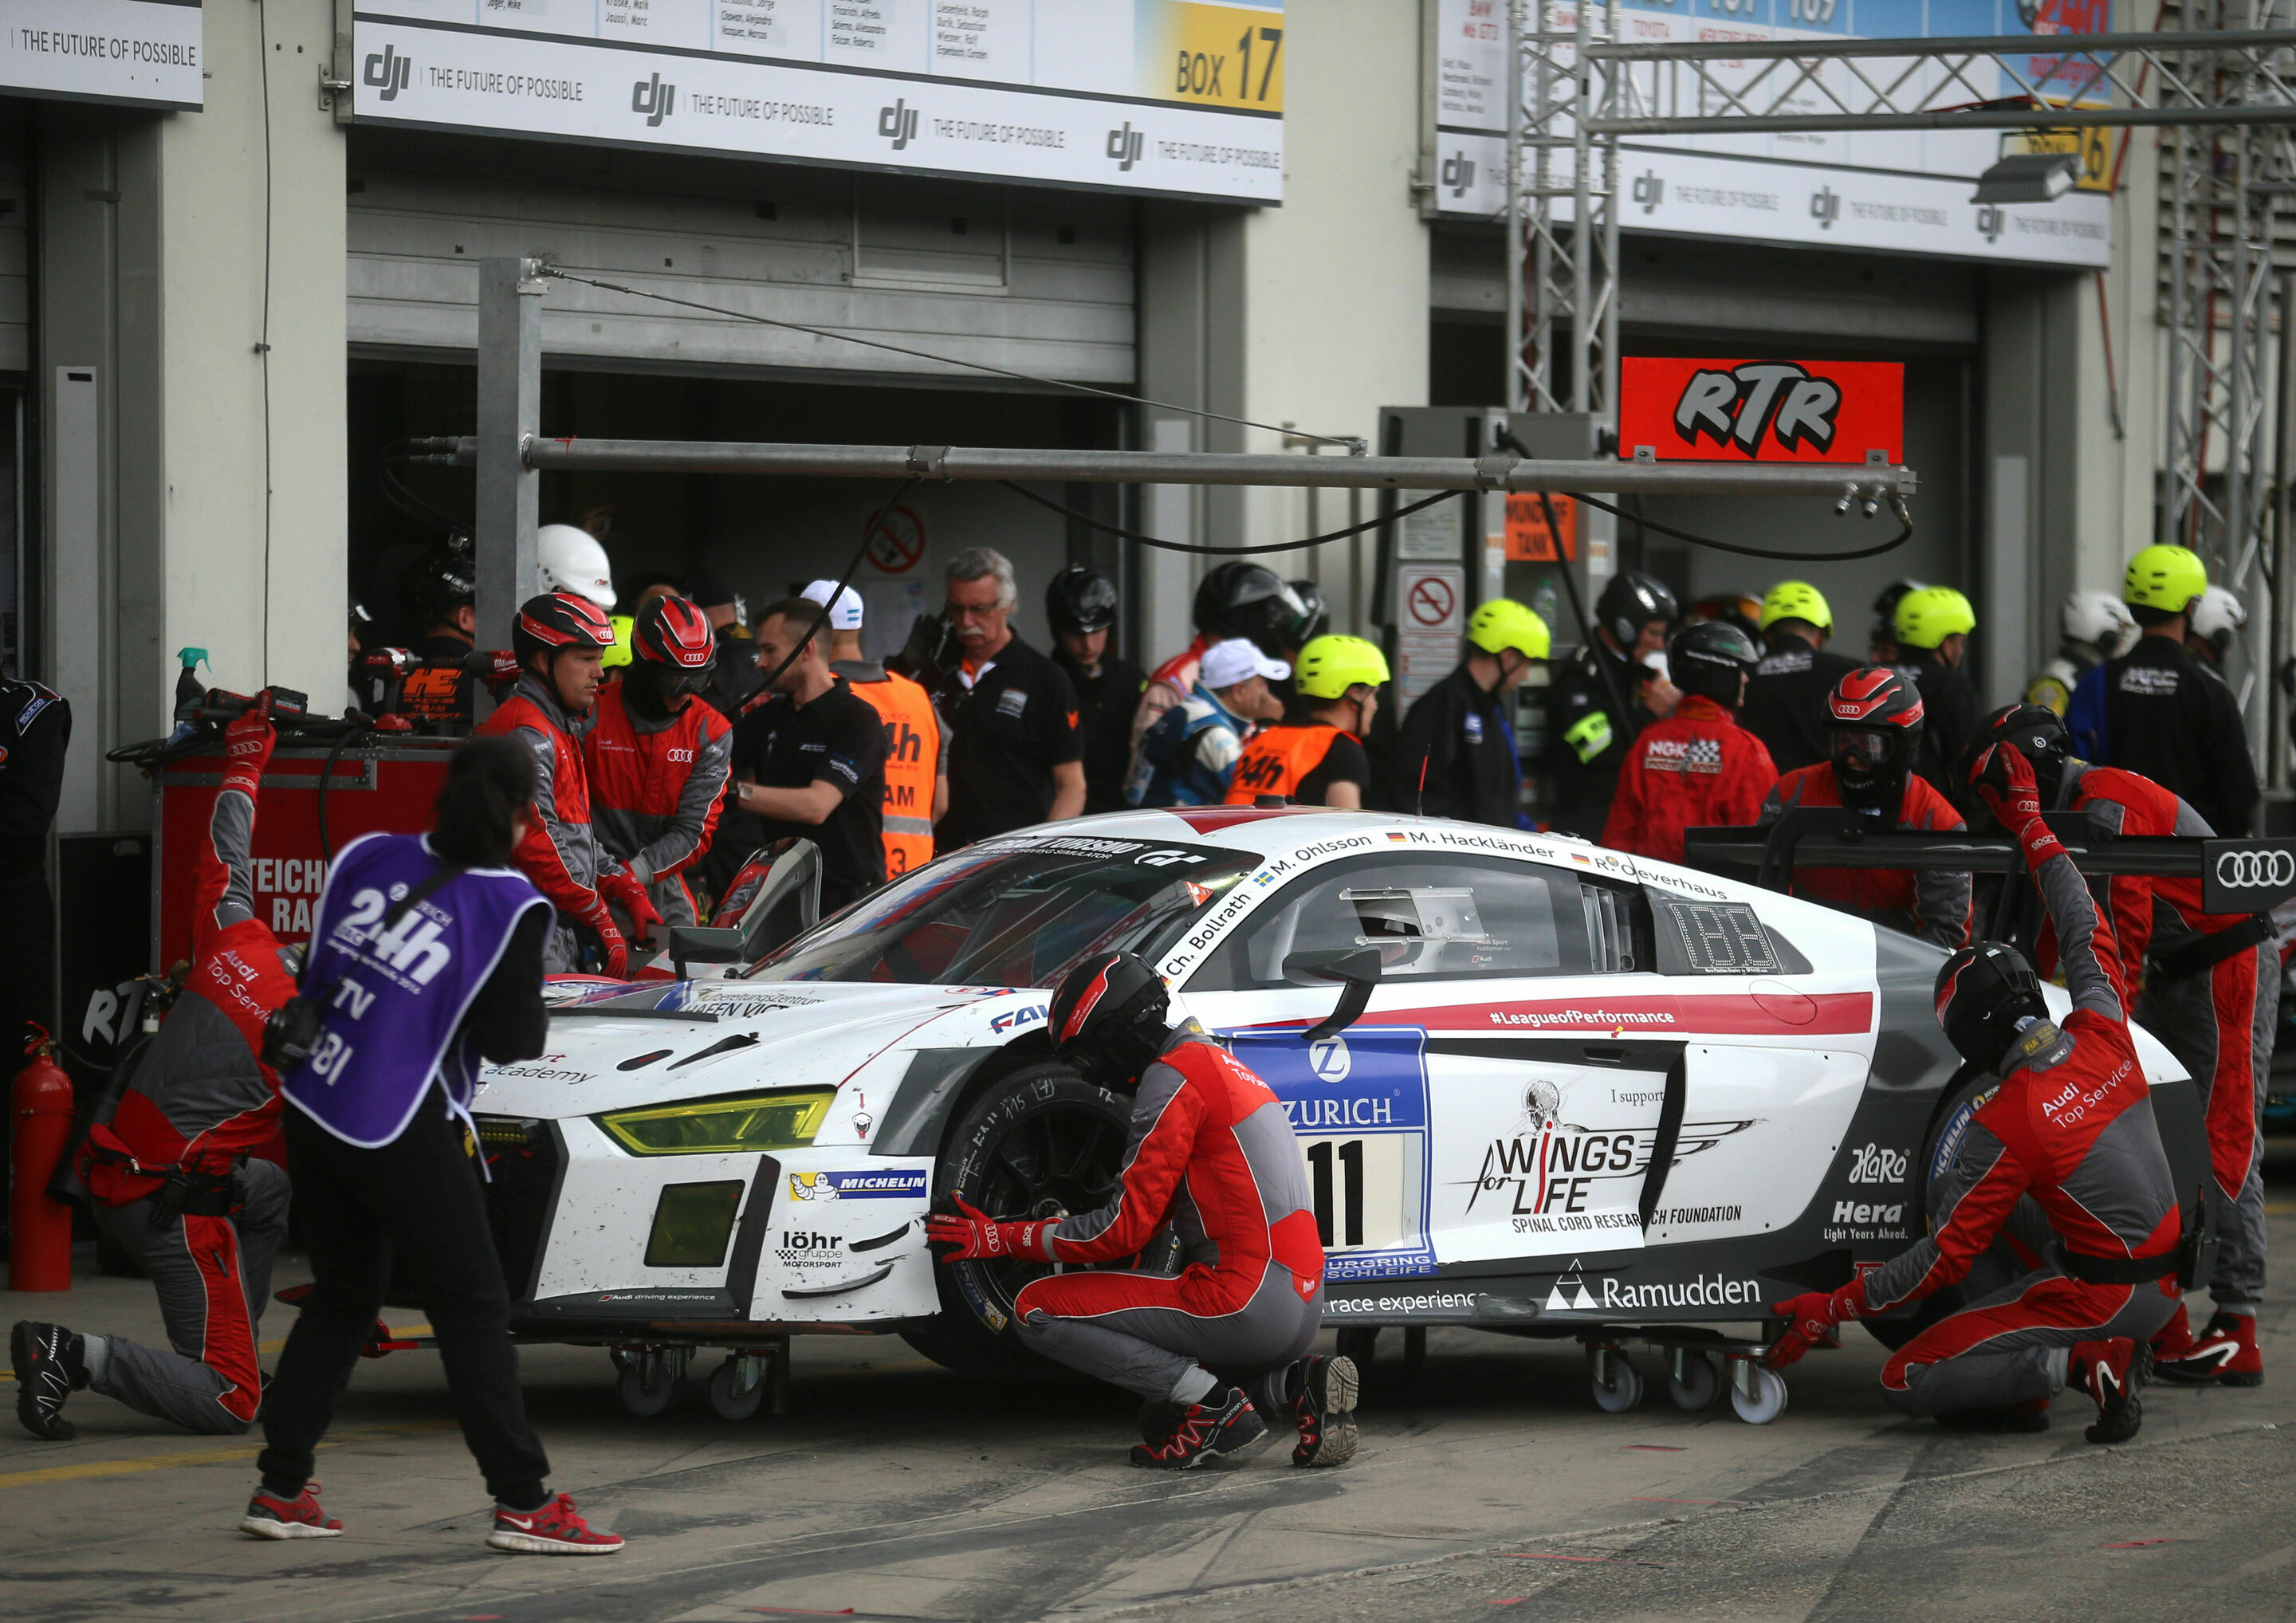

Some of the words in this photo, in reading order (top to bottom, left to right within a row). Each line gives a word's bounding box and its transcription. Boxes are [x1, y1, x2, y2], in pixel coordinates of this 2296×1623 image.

[631, 16, 648, 26] Marc
[22, 29, 49, 53] THE
[53, 33, 106, 58] FUTURE
[110, 38, 129, 61] OF
[133, 41, 197, 67] POSSIBLE
[1176, 50, 1225, 97] BOX
[1238, 26, 1284, 101] 17
[430, 67, 454, 88] THE
[457, 70, 503, 94] FUTURE
[506, 75, 524, 96] OF
[528, 78, 584, 102] POSSIBLE
[692, 94, 714, 115] THE
[718, 96, 761, 120] FUTURE
[762, 102, 779, 120] OF
[782, 103, 834, 126] POSSIBLE
[934, 118, 954, 138] THE
[957, 120, 997, 142] FUTURE
[1001, 125, 1015, 143] OF
[1017, 127, 1065, 149] POSSIBLE
[1158, 140, 1177, 160] THE
[1180, 143, 1217, 163] FUTURE
[1220, 147, 1233, 164] OF
[1236, 148, 1280, 170] POSSIBLE
[1674, 360, 1842, 459] RTR
[1649, 741, 1689, 758] NGK
[883, 784, 914, 808] AM
[1053, 849, 1113, 860] SIMULATOR
[1269, 859, 1297, 876] M.
[1295, 835, 1373, 861] Ohlsson
[1407, 831, 1436, 844] M.
[1440, 832, 1555, 859] Hackländer
[1620, 862, 1728, 901] Oeverhaus
[1166, 954, 1195, 977] Ch.
[1189, 891, 1252, 951] Bollrath
[220, 949, 259, 982] Audi
[206, 956, 231, 986] Top
[229, 983, 271, 1025] Servic
[332, 977, 377, 1021] TV
[1489, 1009, 1676, 1028] #LeagueofPerformance
[484, 1065, 599, 1085] academy
[1611, 1089, 1617, 1102] I
[1620, 1088, 1665, 1106] support
[2041, 1082, 2080, 1118] Audi
[2052, 1105, 2086, 1129] Top
[2082, 1059, 2133, 1109] Service
[1281, 1098, 1392, 1126] ZURICH
[840, 1177, 926, 1189] MICHELIN
[1464, 1142, 1516, 1216] for
[1512, 1177, 1592, 1216] LIFE
[1512, 1217, 1557, 1234] SPINAL
[1561, 1216, 1593, 1232] CORD
[1594, 1209, 1668, 1229] RESEARCH
[1670, 1205, 1742, 1224] FOUNDATION
[1832, 1201, 1903, 1223] Hera
[784, 1231, 843, 1249] löhr
[1824, 1228, 1846, 1242] Light
[1850, 1228, 1874, 1240] Years
[1878, 1228, 1909, 1240] Ahead.
[798, 1249, 843, 1260] gruppe
[1328, 1256, 1431, 1271] URGRING
[1324, 1266, 1432, 1279] SCHLEIFE
[1602, 1273, 1762, 1308] Ramudden
[1330, 1299, 1374, 1314] race
